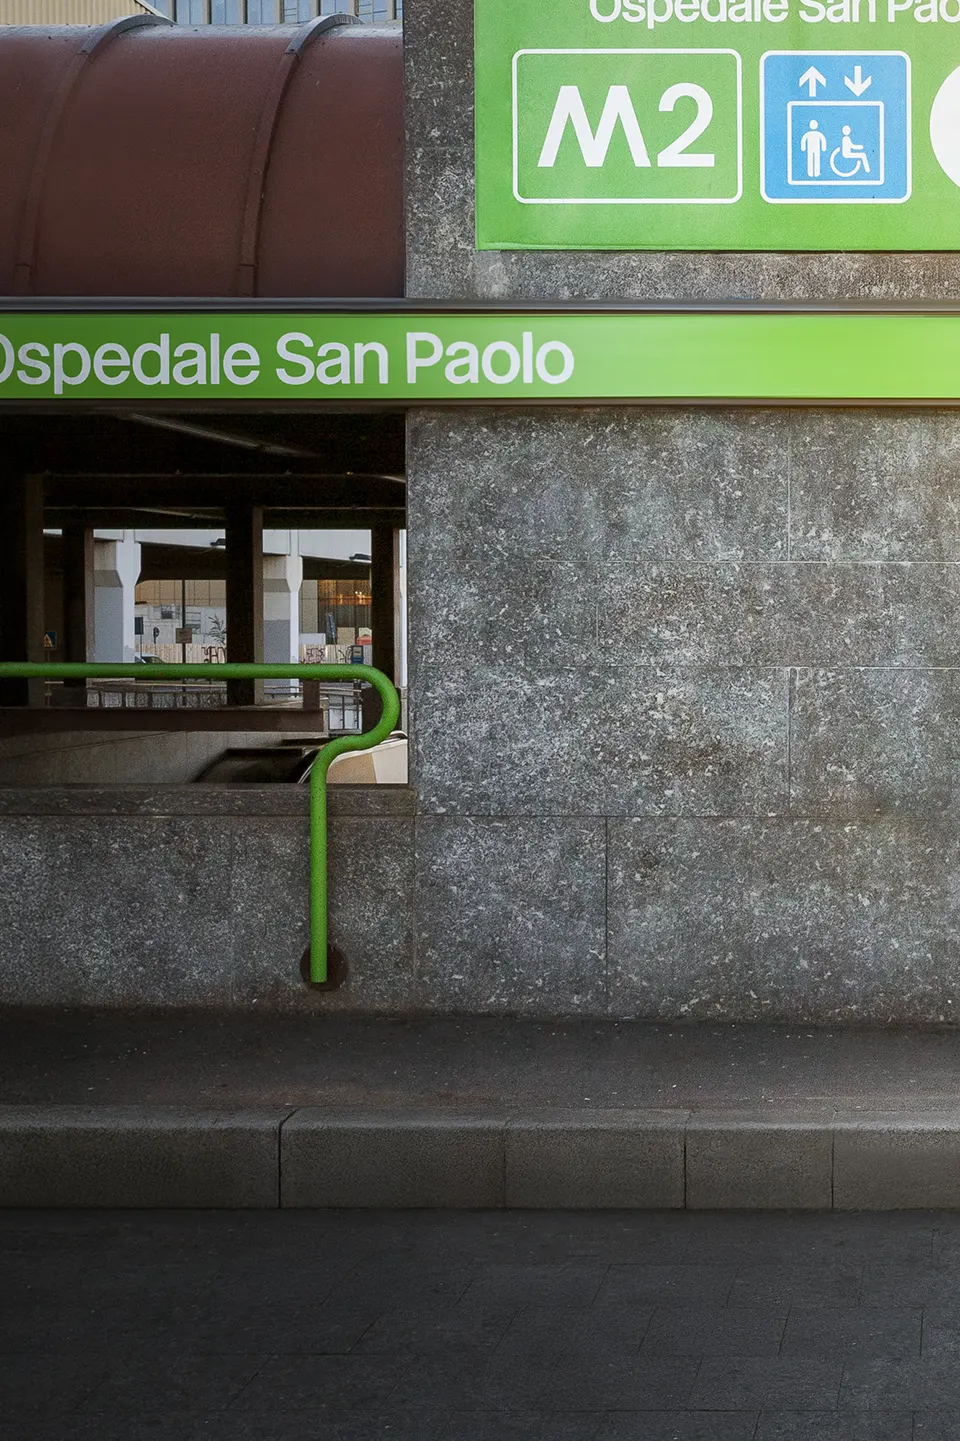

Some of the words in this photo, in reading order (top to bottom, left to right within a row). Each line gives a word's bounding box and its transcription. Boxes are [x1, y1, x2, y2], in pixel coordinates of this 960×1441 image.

[537, 81, 716, 169] M2
[275, 331, 389, 385] San
[405, 331, 575, 385] Paolo
